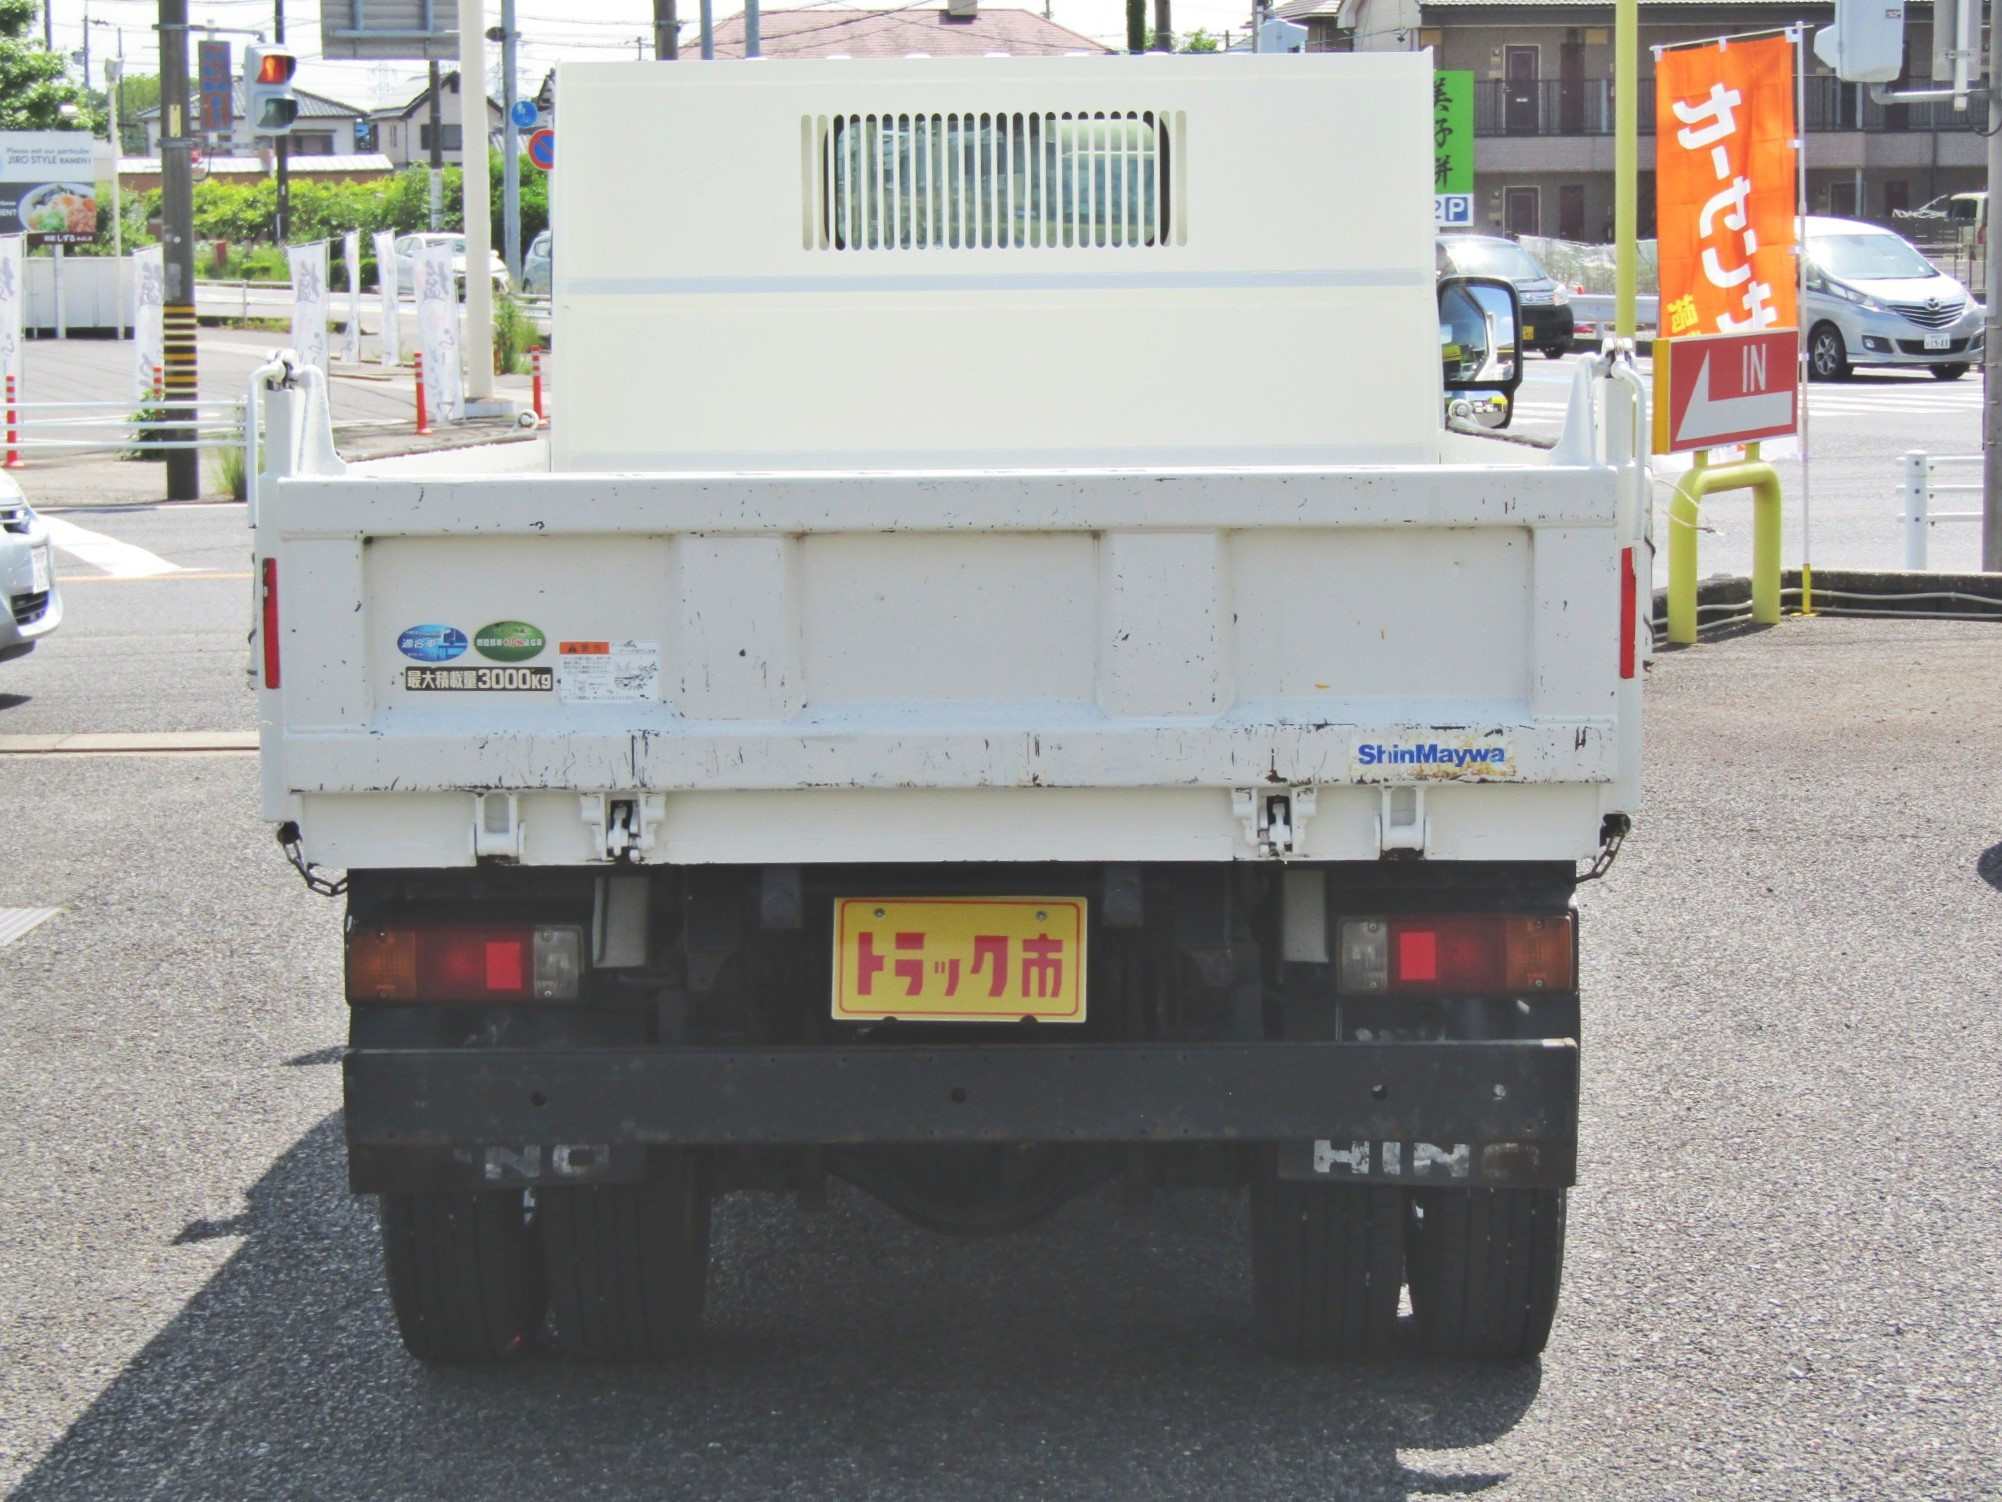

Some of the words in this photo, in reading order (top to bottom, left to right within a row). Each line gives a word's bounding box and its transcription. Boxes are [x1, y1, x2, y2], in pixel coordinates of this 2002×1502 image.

[8, 155, 29, 165] JIRO
[31, 155, 58, 165] STYLE
[1742, 343, 1767, 393] IN
[1358, 744, 1505, 767] ShinMaywa
[857, 932, 1064, 998] トラック市
